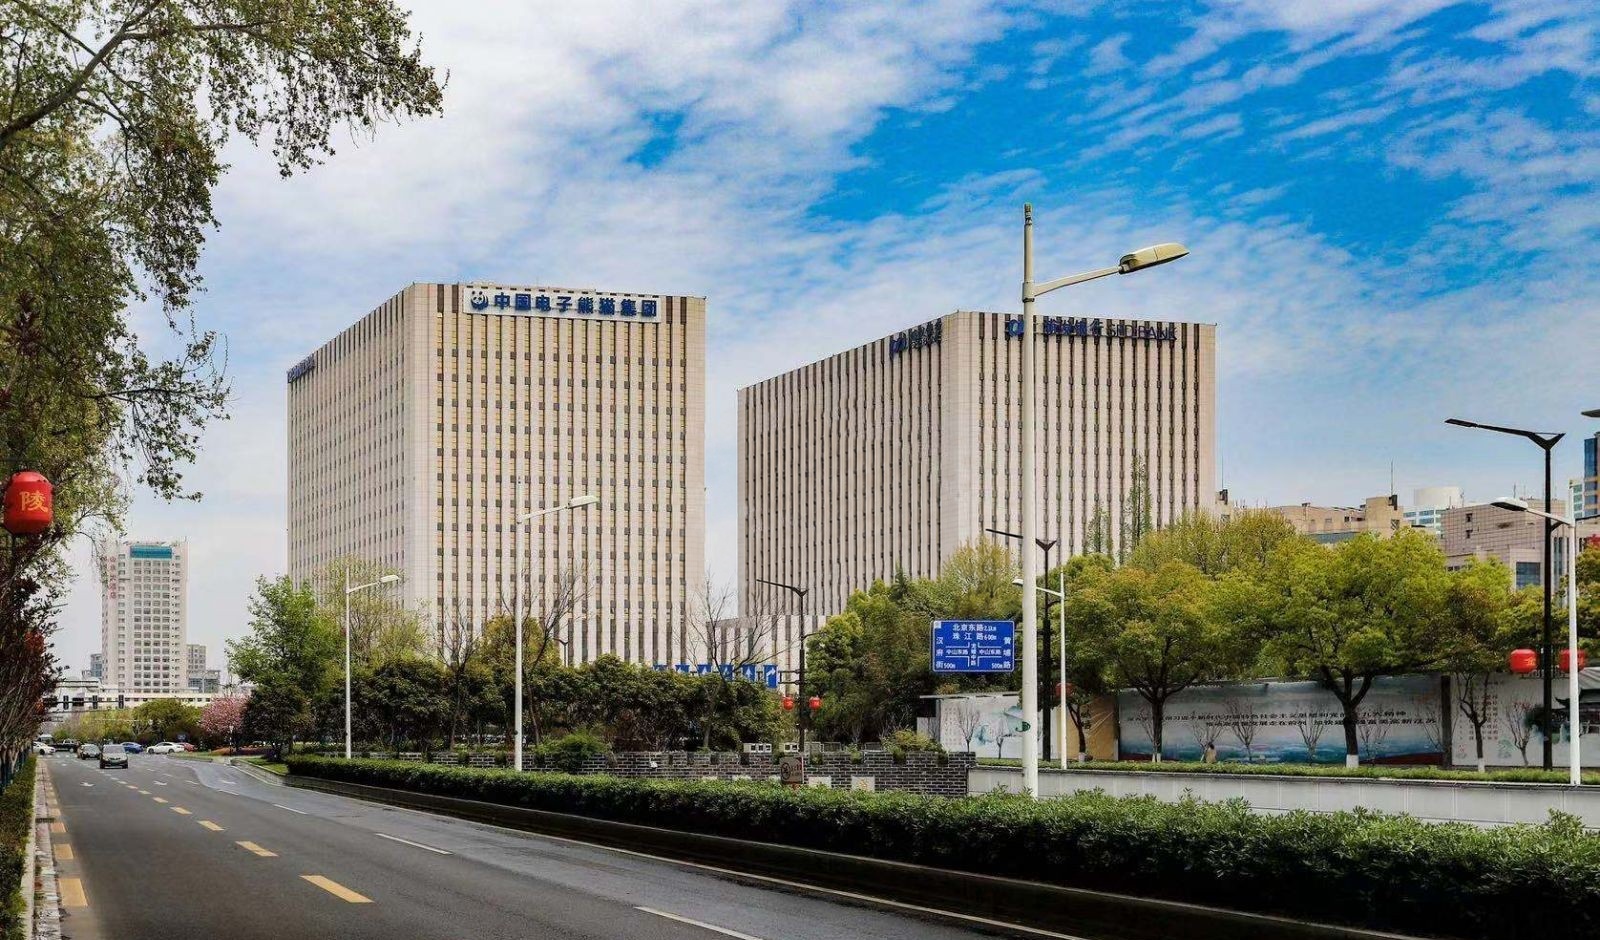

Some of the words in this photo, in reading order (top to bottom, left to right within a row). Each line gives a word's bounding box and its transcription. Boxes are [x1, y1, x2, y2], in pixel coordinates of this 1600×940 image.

[494, 292, 657, 317] 中国电子熊猫集团
[1138, 325, 1177, 340] BANK
[19, 490, 49, 513] 陵
[952, 632, 983, 640] 珠江路
[953, 624, 983, 632] 北京东路
[936, 636, 944, 669] 汉府街
